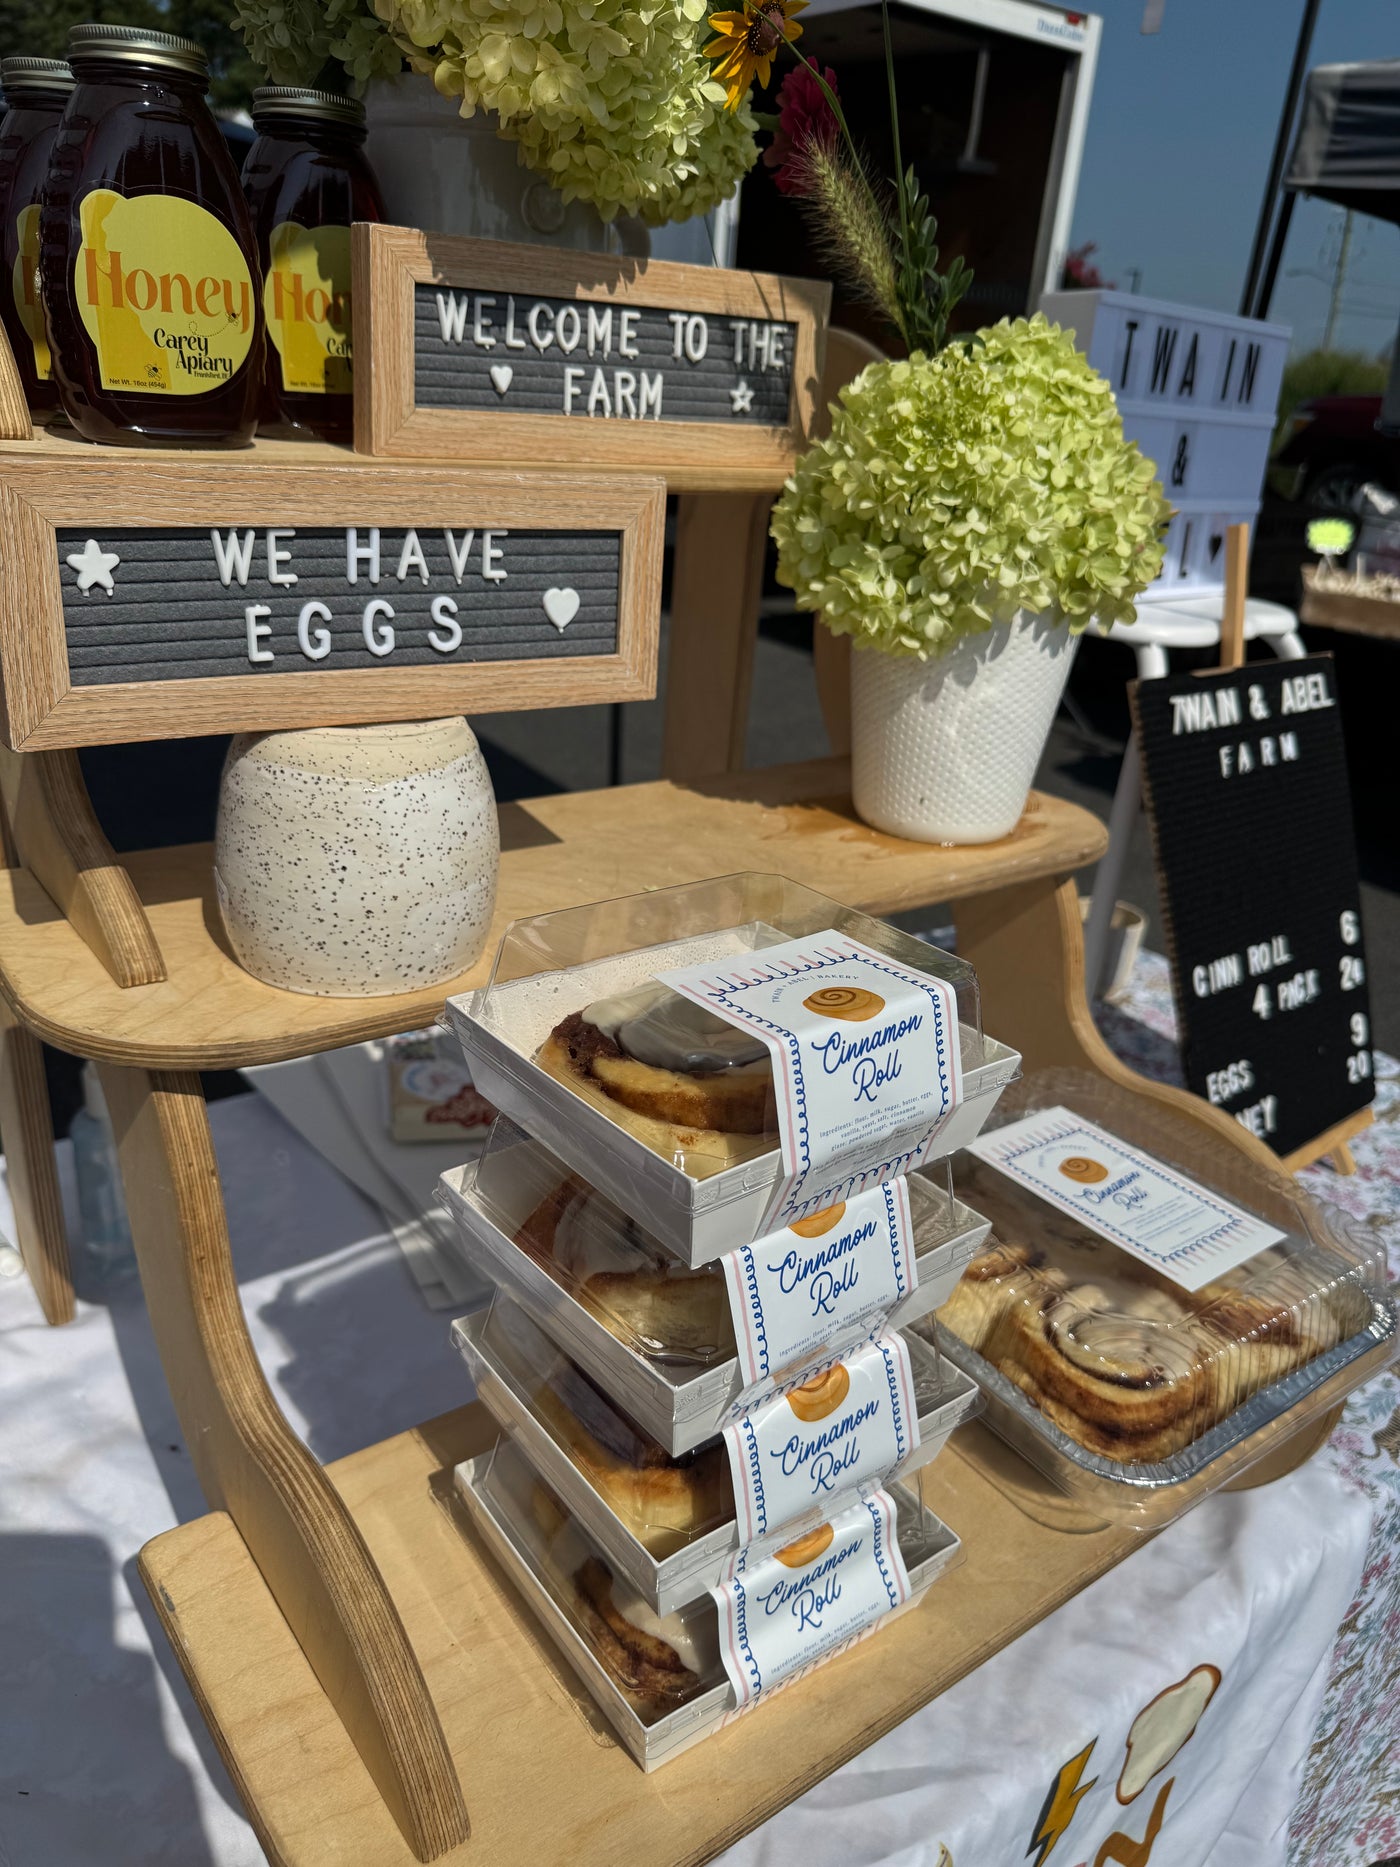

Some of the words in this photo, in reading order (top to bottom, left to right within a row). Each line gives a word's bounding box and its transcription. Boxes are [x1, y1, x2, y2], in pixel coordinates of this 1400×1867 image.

[84, 248, 249, 334] Honey
[154, 328, 208, 356] Carey
[436, 291, 641, 360] WELCOME
[669, 313, 708, 362] TO
[729, 321, 788, 371] THE
[176, 350, 233, 377] Apiary
[563, 367, 663, 420] FARM
[1173, 434, 1187, 486] &
[210, 528, 298, 588] WE
[346, 528, 508, 585] HAVE
[245, 596, 462, 662] EGGS
[1249, 683, 1270, 720] &
[1281, 672, 1335, 715] ABEL
[1219, 731, 1299, 779] FARM
[1192, 953, 1244, 998] CINN
[1247, 935, 1293, 977] ROLL
[1340, 910, 1360, 945] 6
[1252, 983, 1273, 1020] 4
[1278, 969, 1320, 1012] PACK
[811, 1015, 923, 1074] Cinnamon
[1206, 1059, 1255, 1104] EGGS
[1350, 1012, 1369, 1047] 9
[1346, 1050, 1371, 1084] 20
[853, 1049, 902, 1102] Roll
[1073, 1170, 1141, 1205] Cinnamon
[1112, 1186, 1148, 1211] Roll
[767, 1221, 877, 1294] Cinnamon
[810, 1258, 858, 1316] Roll
[770, 1400, 879, 1475] Cinnamon
[810, 1437, 860, 1494] Roll
[756, 1538, 863, 1615] Cinnamon
[792, 1573, 841, 1632] Roll
